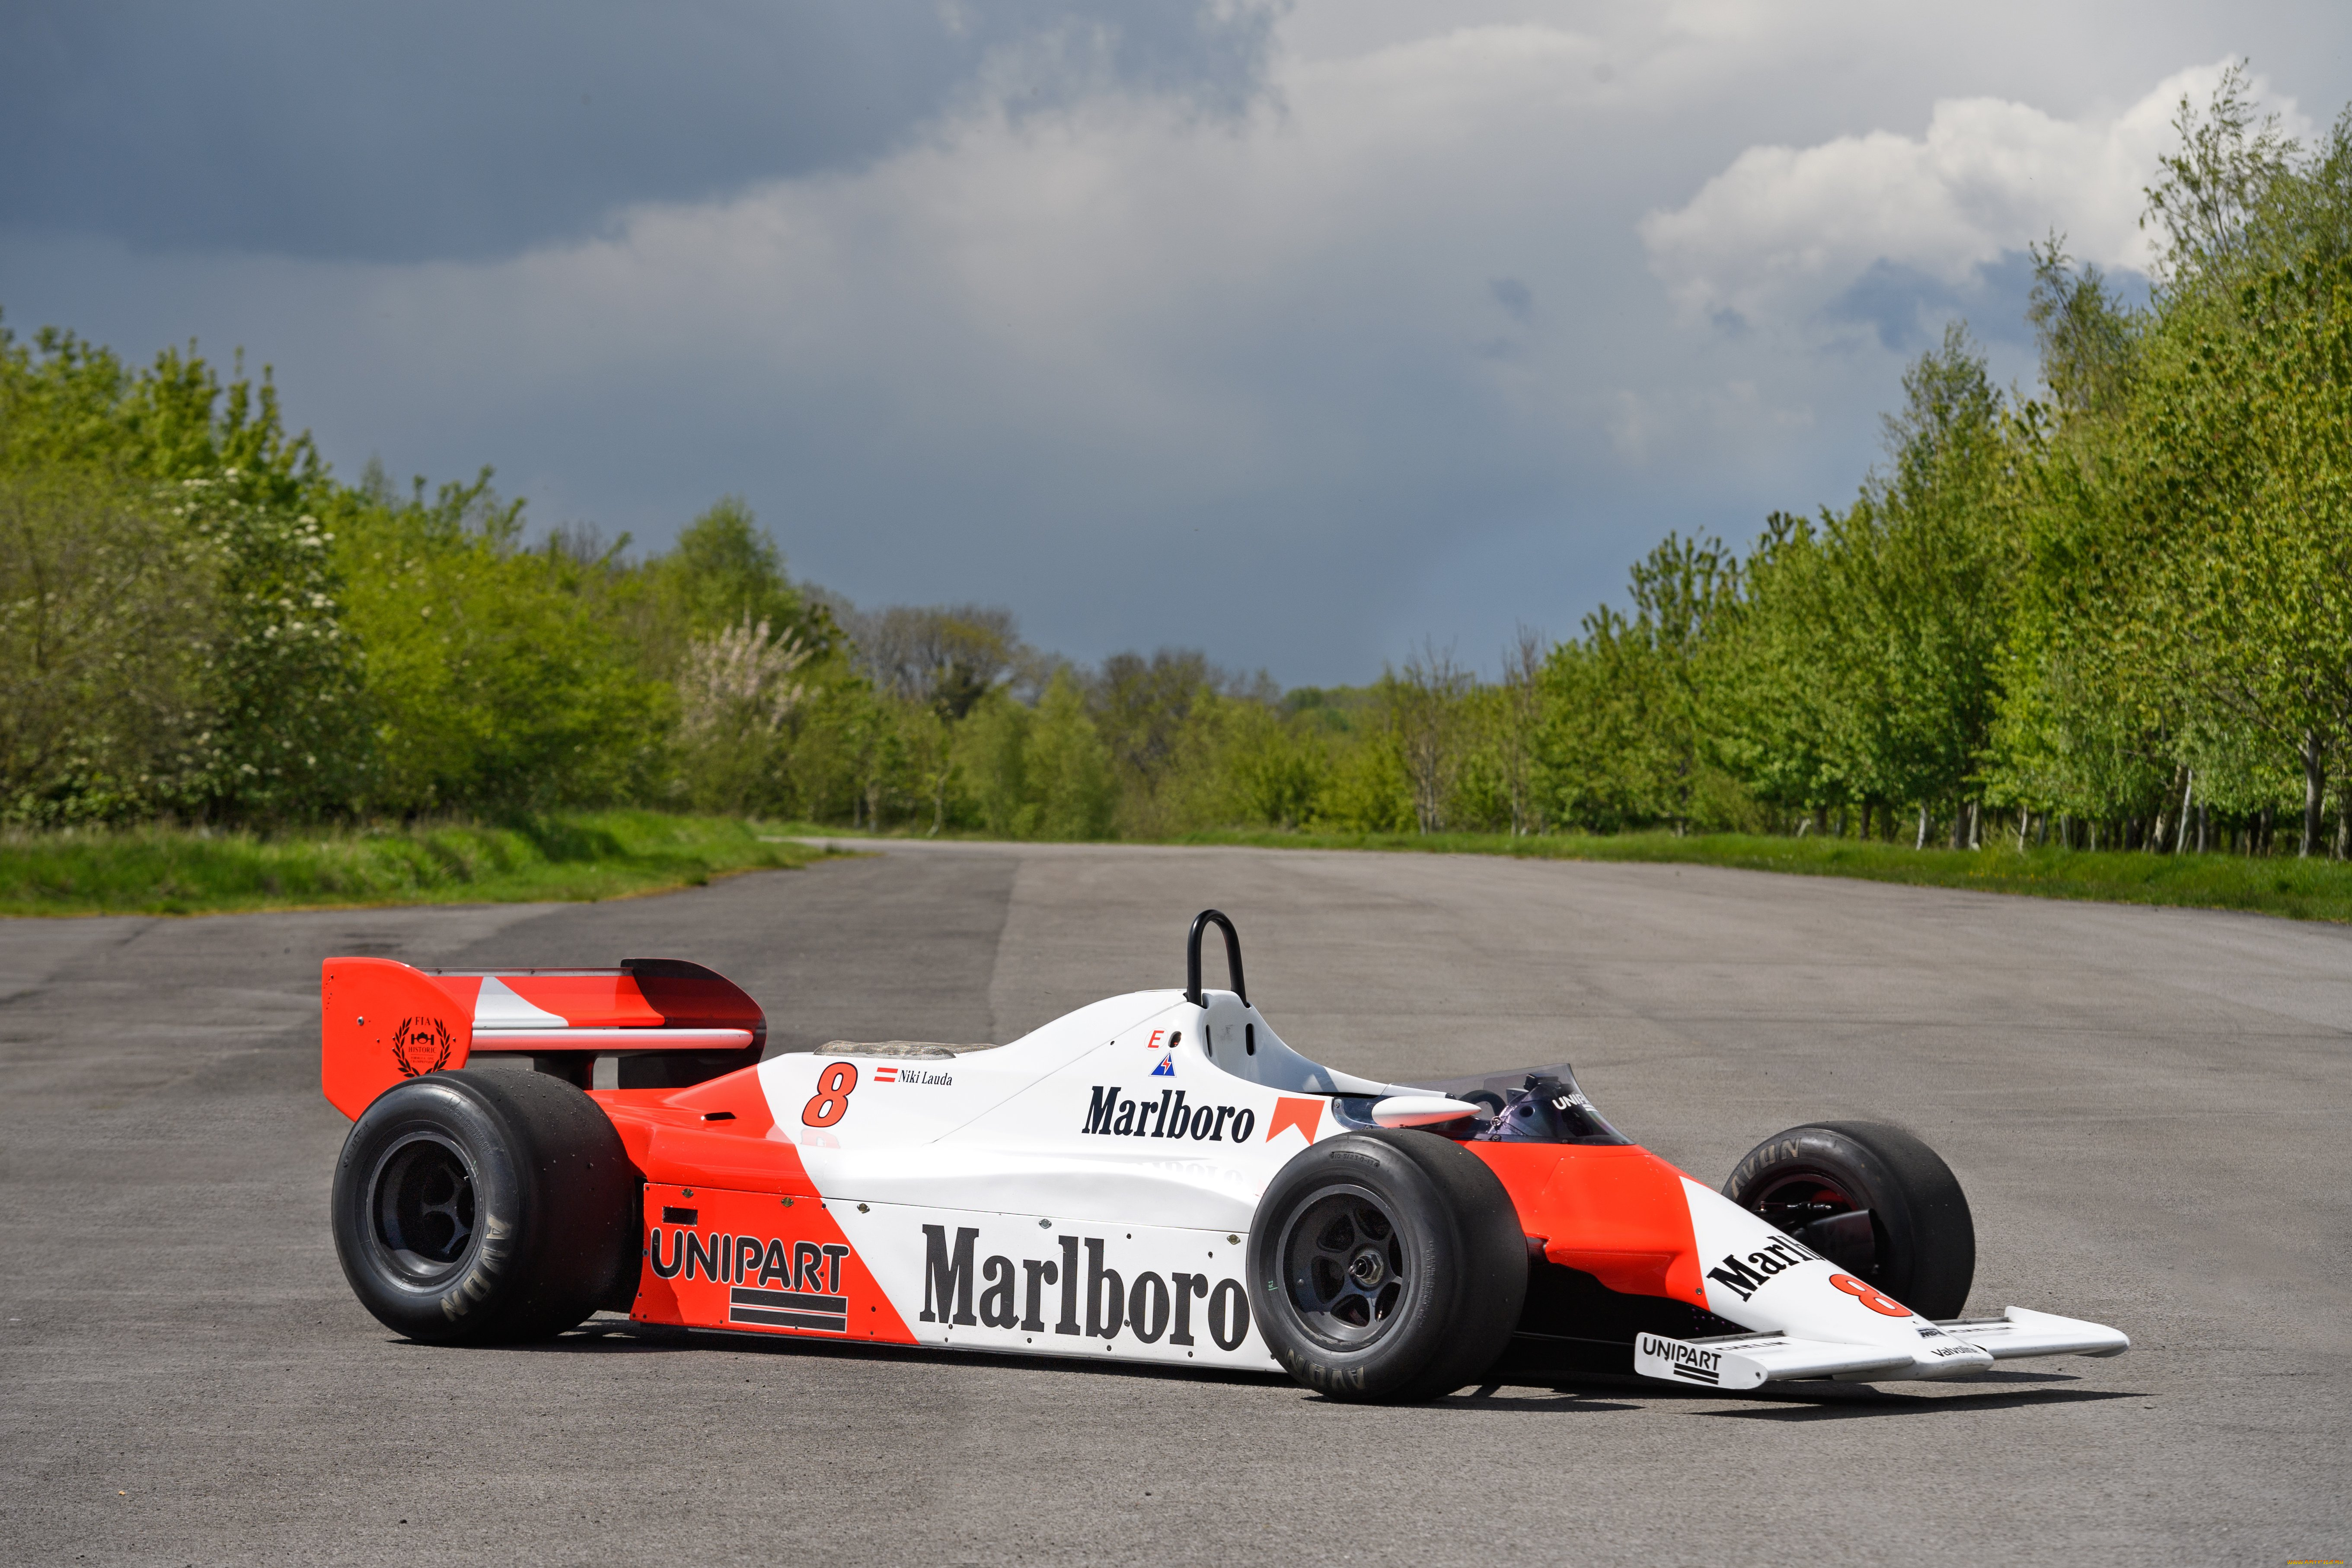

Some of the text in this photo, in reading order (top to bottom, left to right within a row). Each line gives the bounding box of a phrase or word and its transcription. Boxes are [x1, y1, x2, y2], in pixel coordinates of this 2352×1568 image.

[415, 1016, 431, 1025] FIA
[1148, 1030, 1164, 1048] E
[801, 1062, 858, 1127] 8
[898, 1070, 952, 1086] Niki Lauda
[1082, 1086, 1254, 1143] Marlboro
[1731, 1137, 1802, 1199] AVON
[651, 1227, 850, 1294] UNIPART
[919, 1224, 1250, 1351] Marlboro
[1706, 1236, 1825, 1302] Marlb
[1829, 1274, 1914, 1317] 8
[1643, 1337, 1722, 1371] UNIPART
